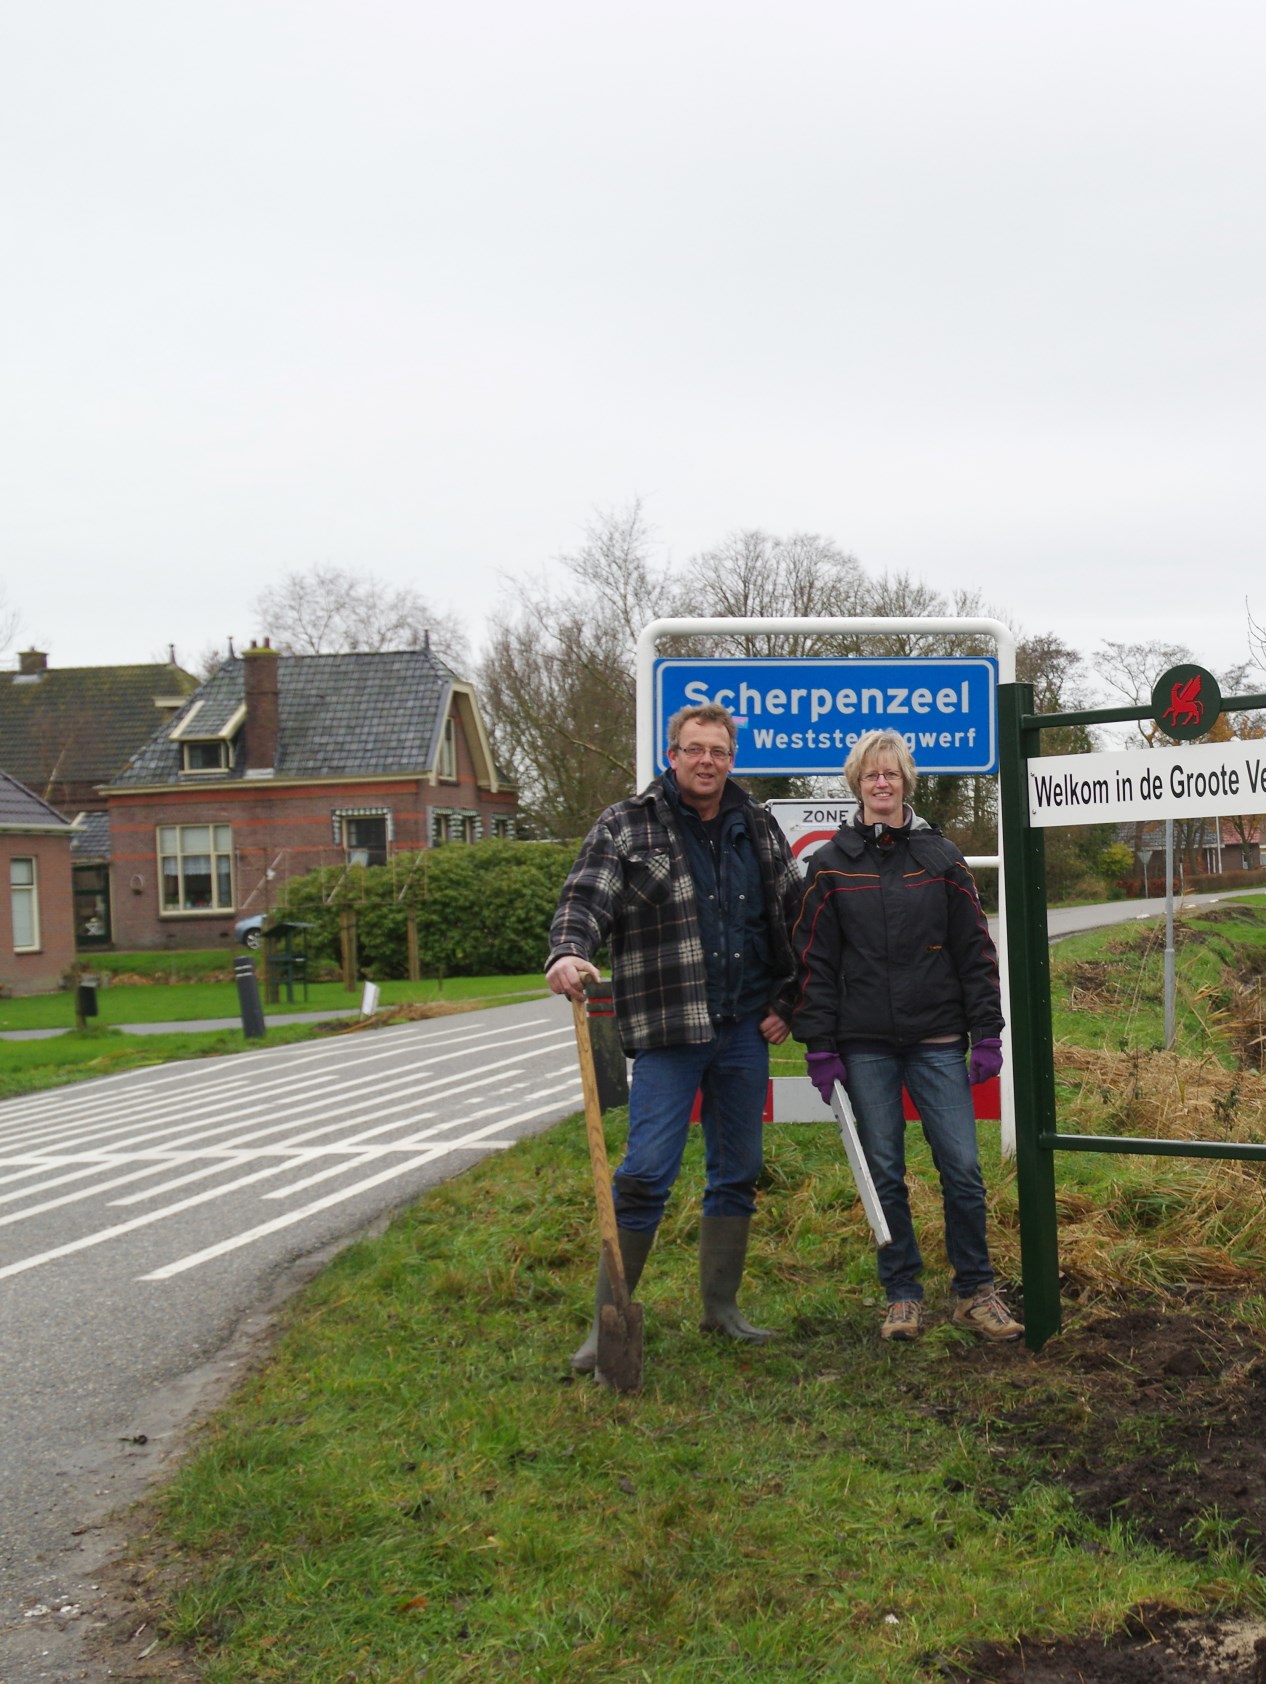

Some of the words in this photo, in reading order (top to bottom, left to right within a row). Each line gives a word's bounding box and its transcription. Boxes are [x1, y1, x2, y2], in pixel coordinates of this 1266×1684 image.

[684, 680, 969, 722] Scherpenzeel
[753, 727, 976, 752] Weststegwerf
[1034, 773, 1110, 807] Welkom
[1115, 770, 1134, 803] in
[1139, 768, 1164, 801] de
[1169, 763, 1240, 798] Groote
[802, 810, 849, 823] ZONE
